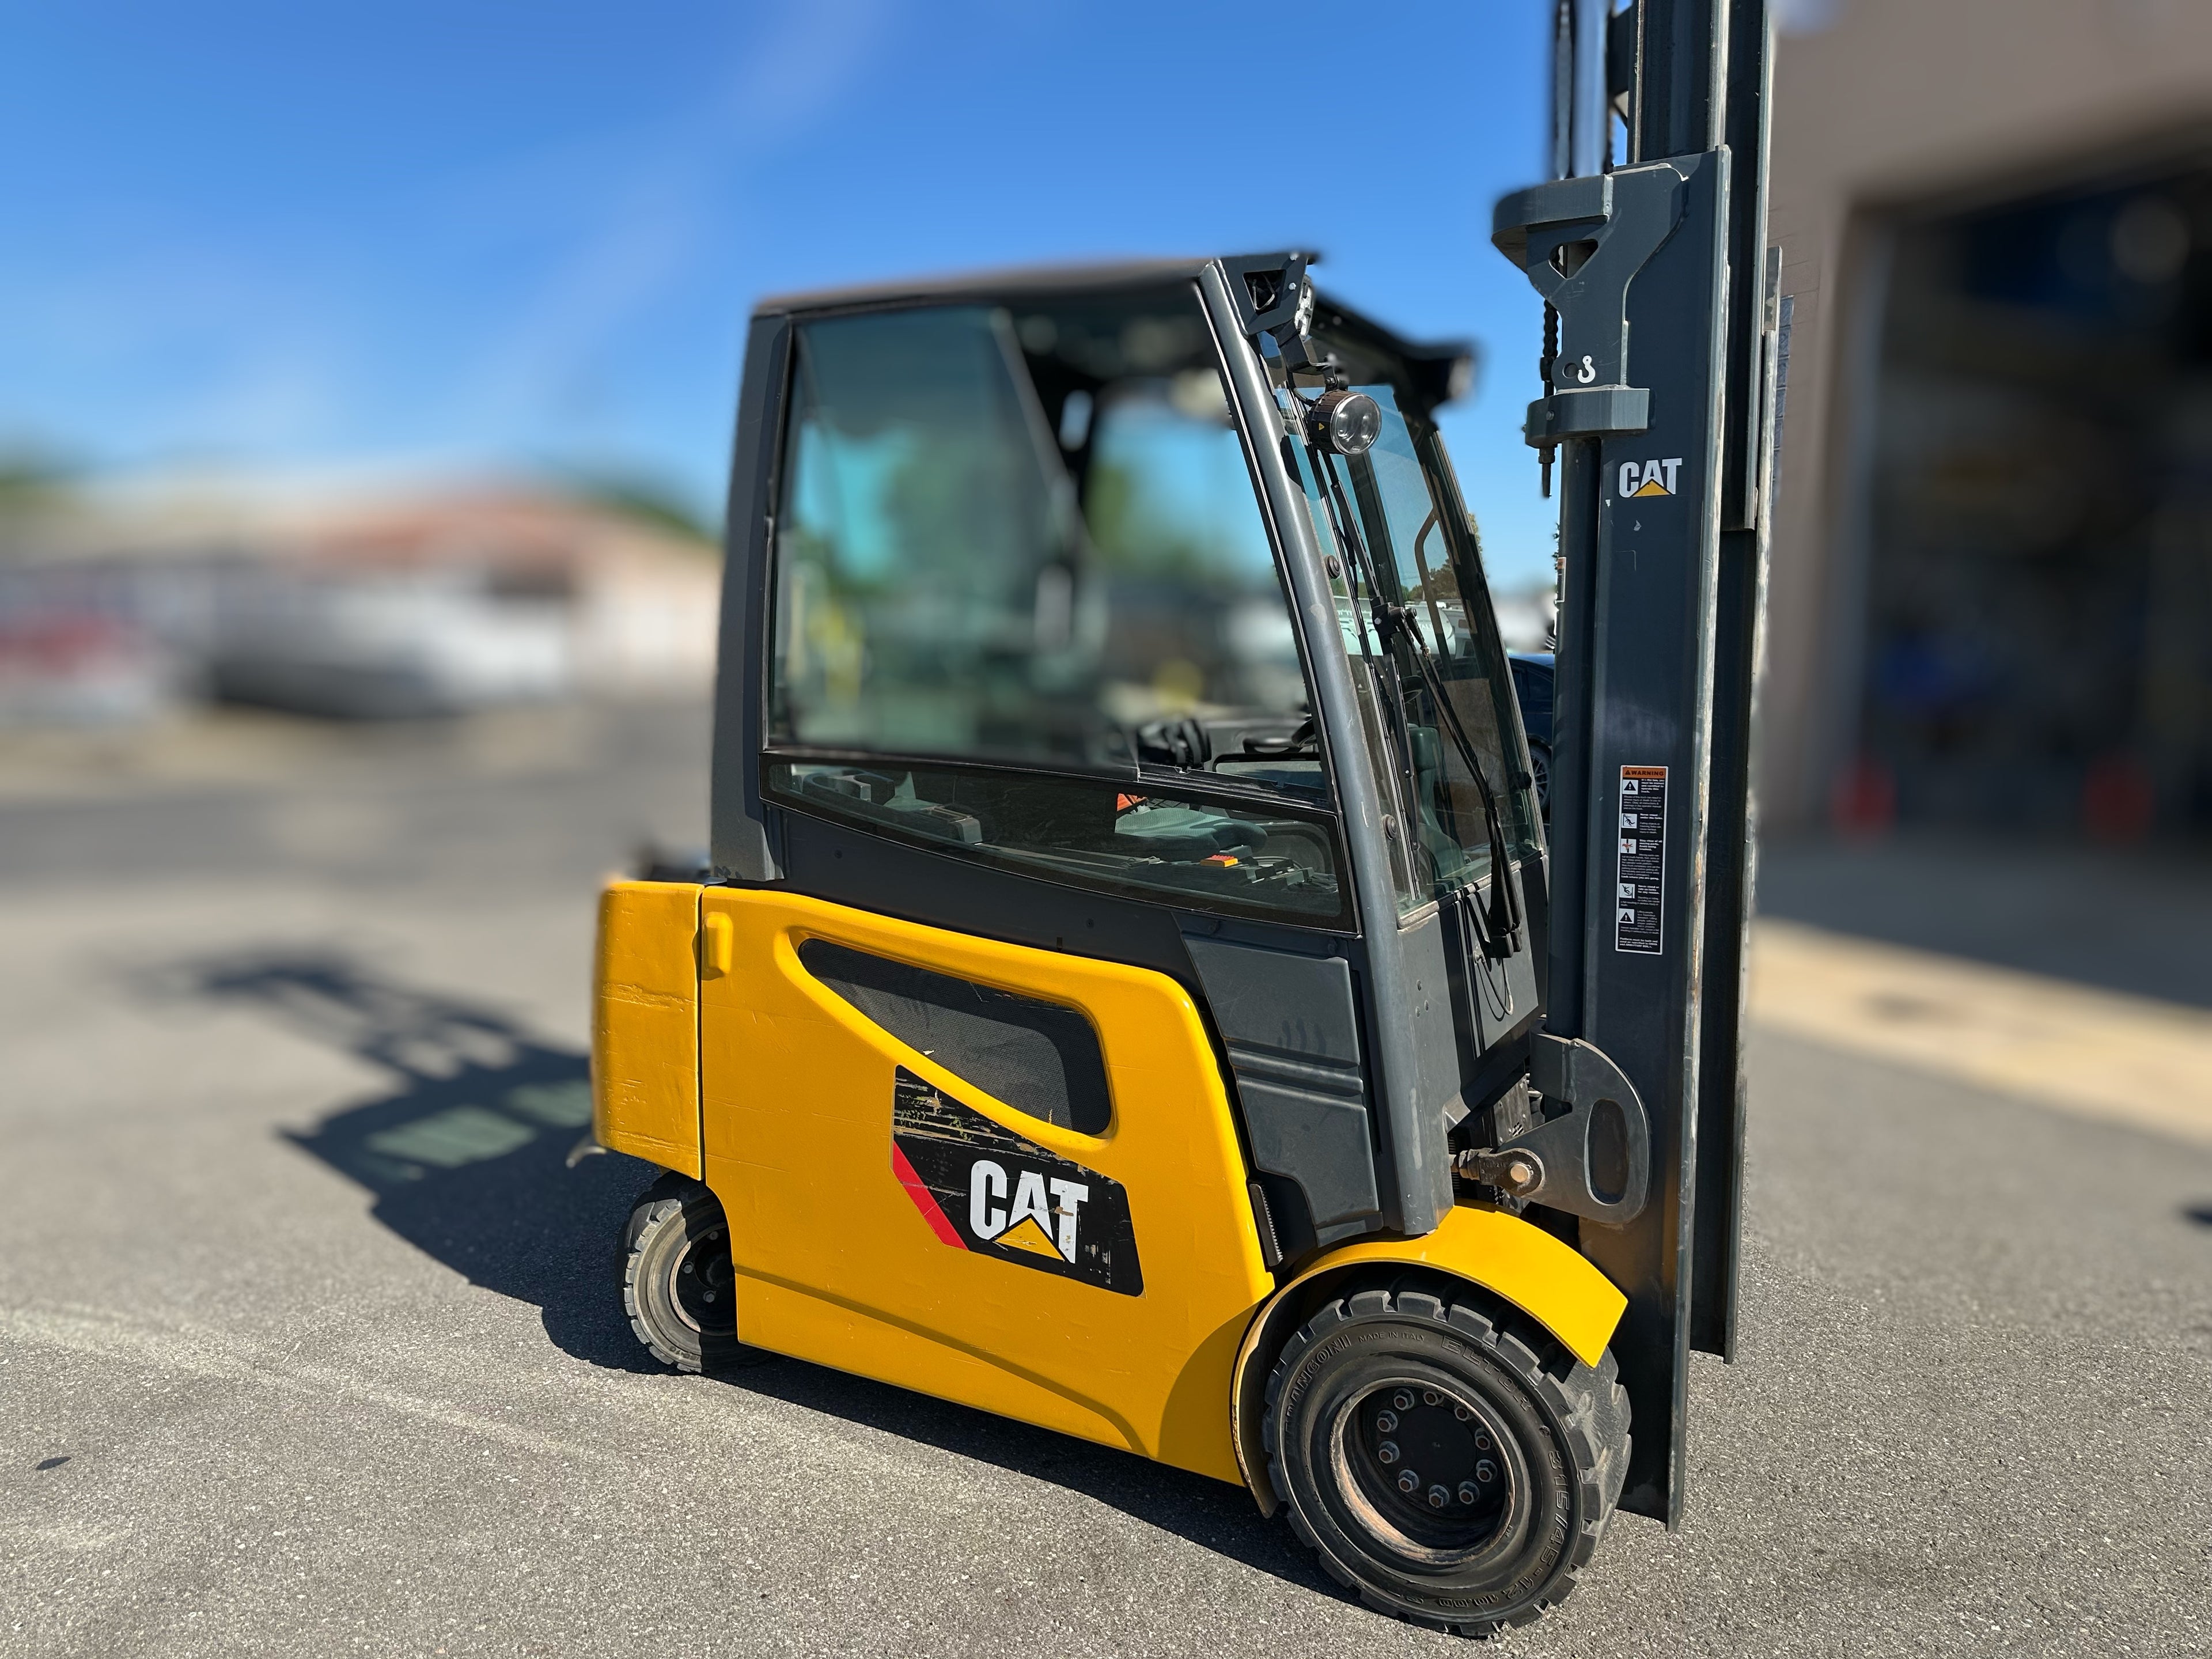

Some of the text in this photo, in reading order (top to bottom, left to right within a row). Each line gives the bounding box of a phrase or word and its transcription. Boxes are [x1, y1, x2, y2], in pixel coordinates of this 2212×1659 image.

[1619, 457, 1682, 498] CAT
[970, 1160, 1089, 1264] CAT
[1358, 1332, 1385, 1343] MADE
[1401, 1331, 1426, 1342] ITALY
[1441, 1335, 1533, 1412] ELTOR
